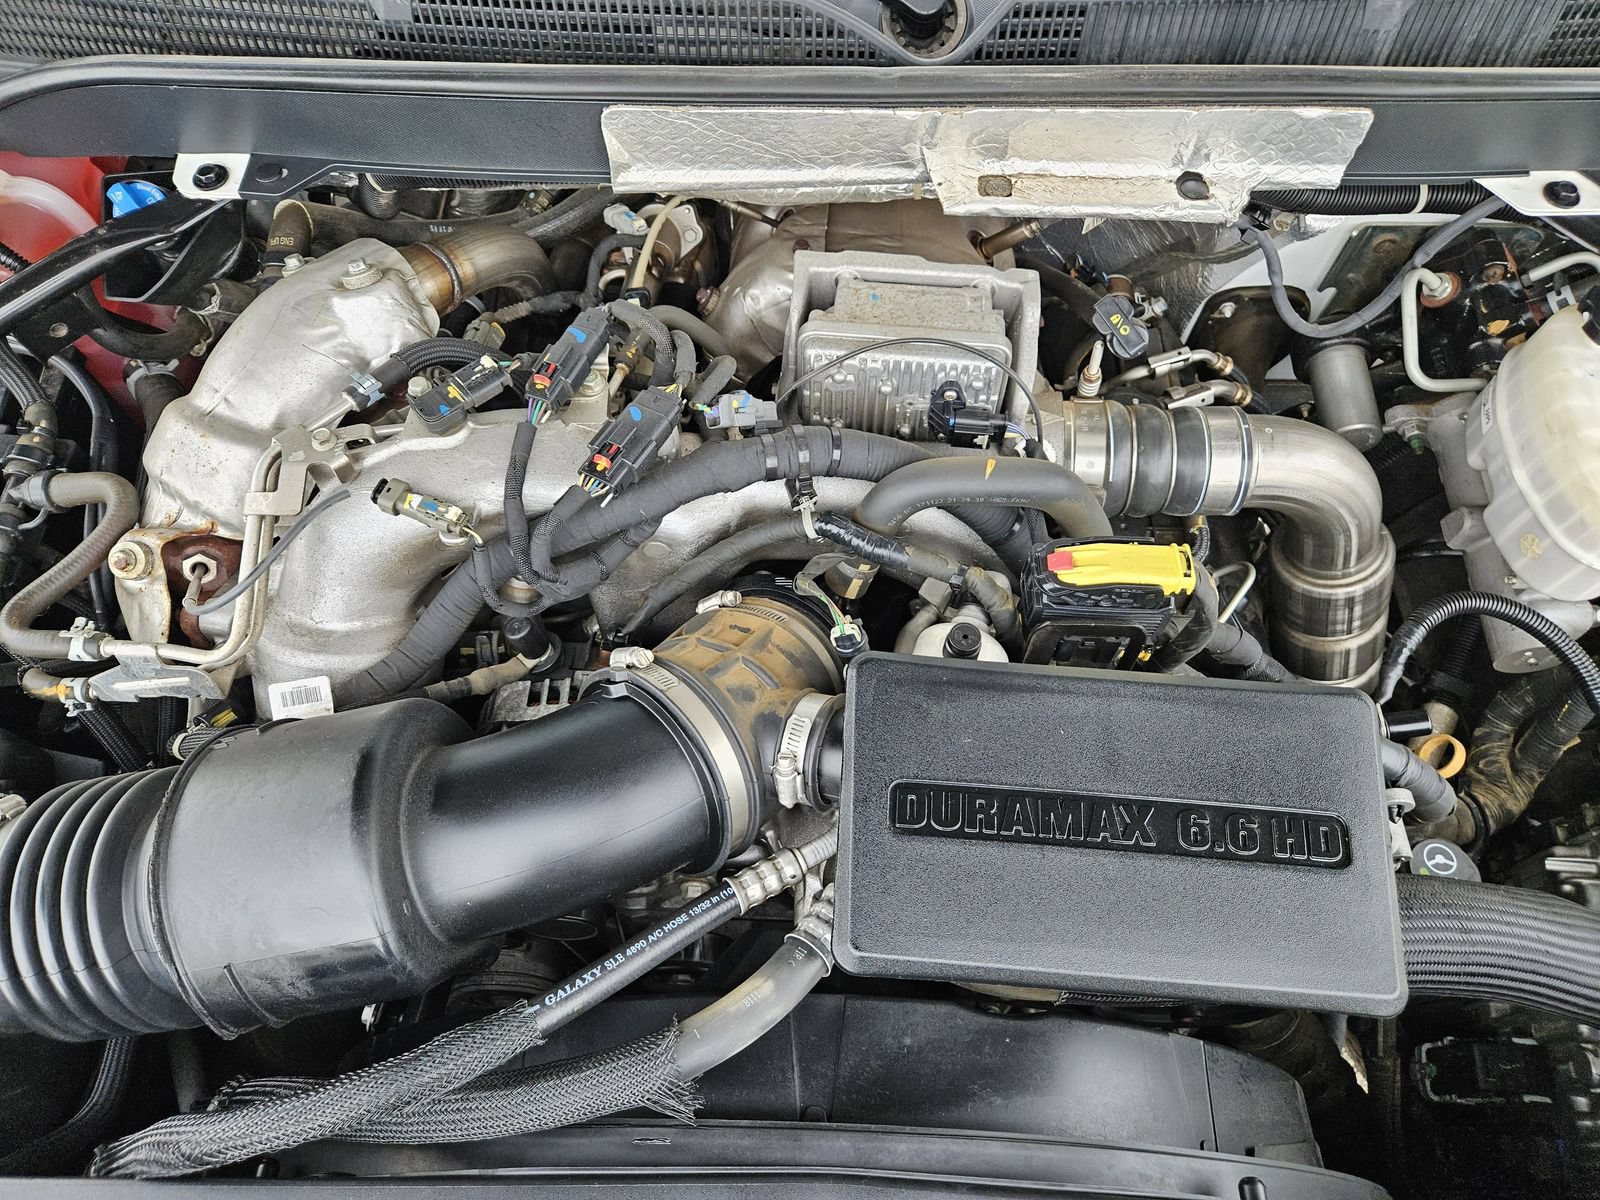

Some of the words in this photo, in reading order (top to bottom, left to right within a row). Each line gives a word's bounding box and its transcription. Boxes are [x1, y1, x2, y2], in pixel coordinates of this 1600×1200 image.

[280, 236, 294, 246] ENG
[895, 792, 1157, 846] DURAMAX
[1176, 808, 1261, 856] 6.6
[1272, 817, 1344, 862] HD
[544, 965, 602, 1006] GALAXY
[626, 939, 648, 957] 4890
[647, 928, 664, 944] A/C
[663, 912, 690, 933] HOSE
[688, 899, 712, 917] 13/32
[710, 895, 720, 904] in
